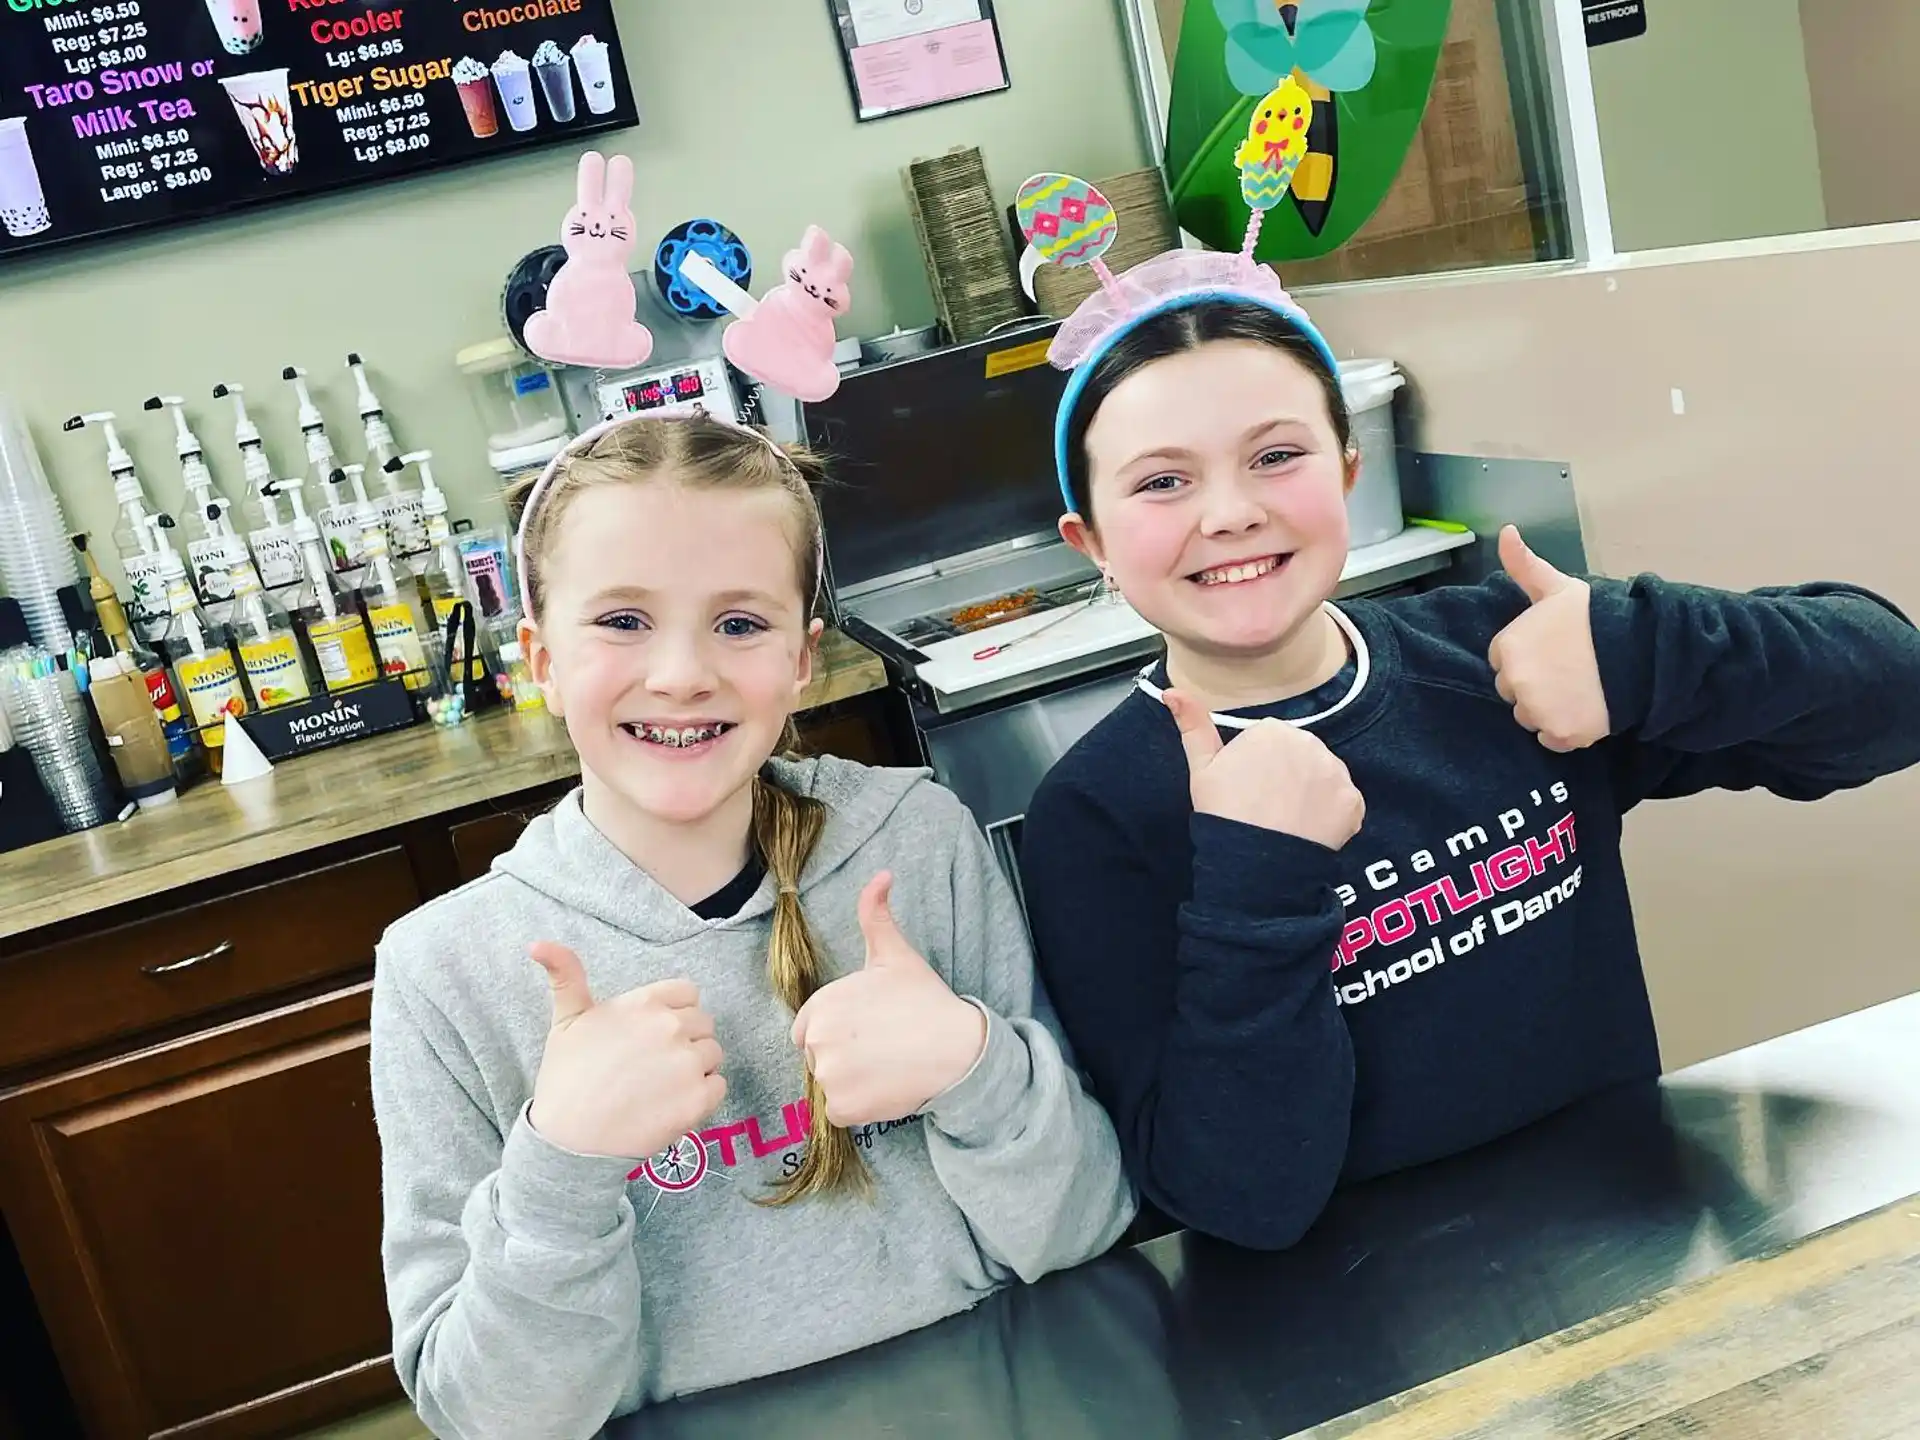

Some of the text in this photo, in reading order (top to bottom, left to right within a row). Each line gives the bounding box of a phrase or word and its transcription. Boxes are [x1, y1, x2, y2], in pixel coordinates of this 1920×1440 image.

[44, 1, 140, 32] Mini: $6.50
[311, 8, 404, 44] Cooler
[462, 0, 582, 32] Chocolate
[1587, 4, 1639, 24] RESTROOM
[52, 22, 147, 53] Reg: $7.25
[64, 44, 147, 75] Lg: $8.00
[326, 51, 356, 68] Lg:
[24, 57, 215, 110] Taro Snow or
[290, 57, 452, 108] Tiger Sugar
[72, 97, 198, 139] Milk Tea
[336, 92, 425, 124] Mini: $6.50
[342, 112, 431, 143] Reg: $7.25
[95, 128, 190, 161] Mini: $6.50
[354, 133, 430, 163] Lg: $8.00
[101, 148, 199, 181] Reg: $7.25
[100, 166, 212, 202] Large: $8.00
[288, 703, 360, 734] MONIN
[295, 720, 365, 745] Flavor Station
[1331, 811, 1576, 973] POTLIGHT
[1450, 914, 1487, 956] of
[1490, 865, 1583, 936] Dance
